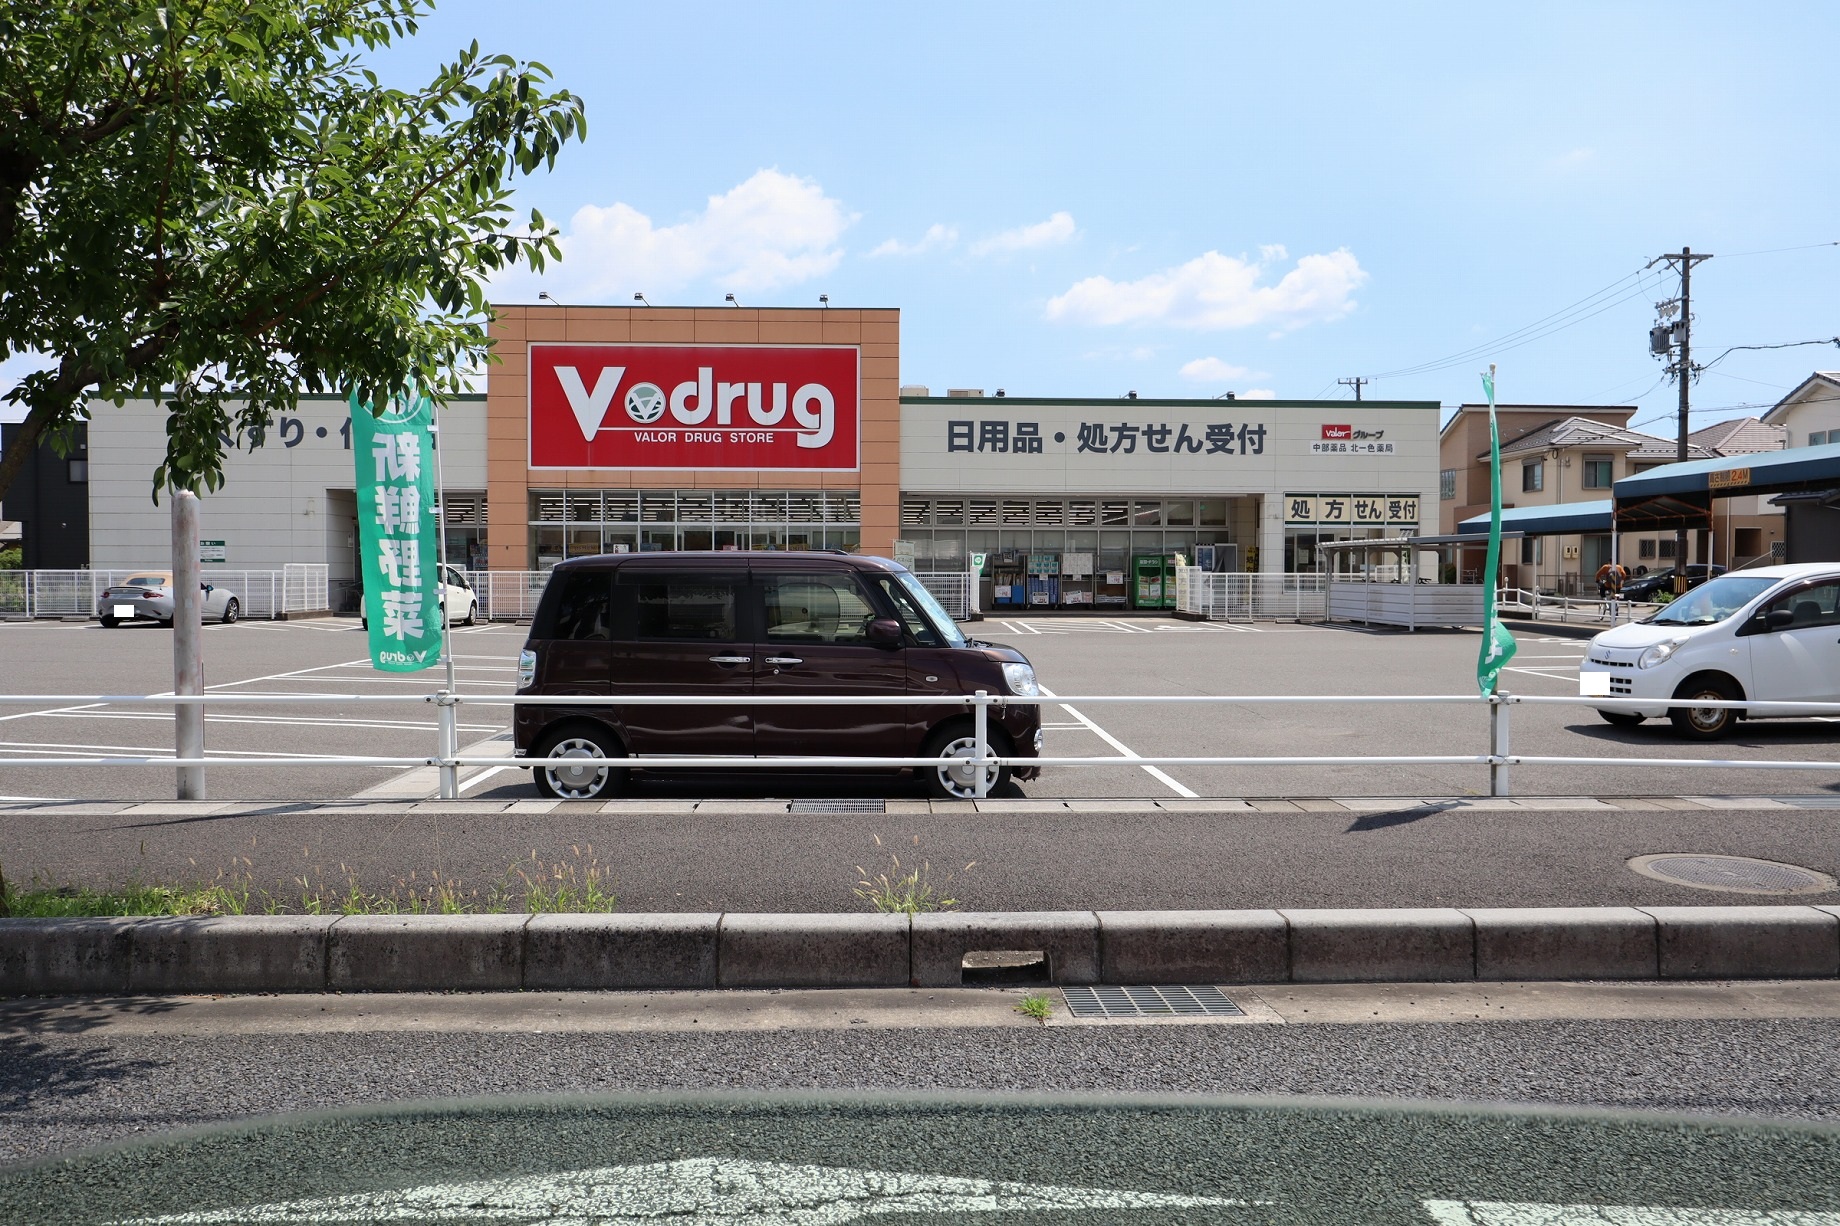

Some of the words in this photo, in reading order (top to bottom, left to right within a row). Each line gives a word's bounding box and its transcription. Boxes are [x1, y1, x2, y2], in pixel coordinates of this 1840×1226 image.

[634, 432, 677, 443] VALOR
[685, 432, 722, 443] DRUG
[730, 432, 774, 443] STORE
[947, 420, 1267, 455] 日用品・処方せん受付
[1352, 429, 1384, 439] グループ
[1312, 443, 1347, 453] 中部薬品
[1350, 443, 1394, 453] 北一色薬局
